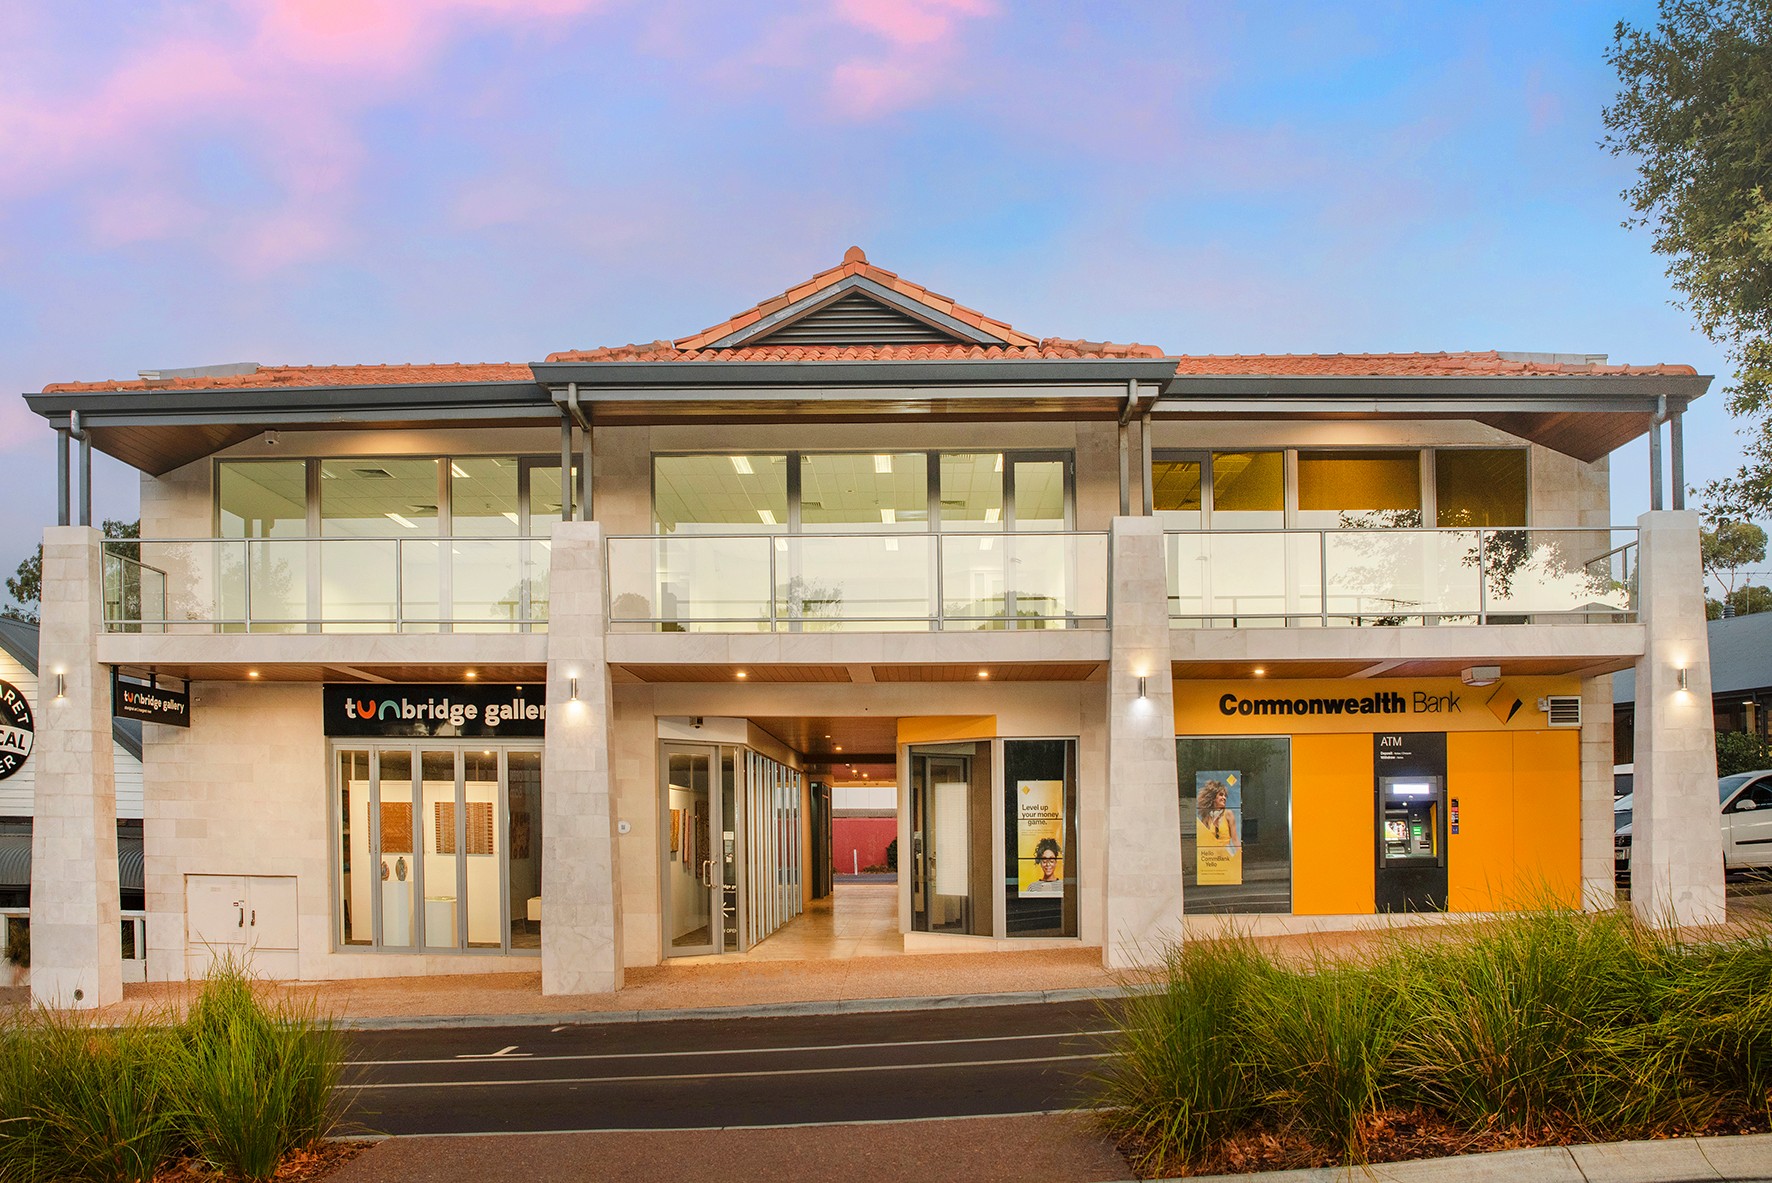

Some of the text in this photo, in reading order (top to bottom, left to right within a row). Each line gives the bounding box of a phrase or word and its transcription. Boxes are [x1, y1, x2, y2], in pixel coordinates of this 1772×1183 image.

[124, 690, 162, 711] tunbridge
[162, 699, 185, 715] gallery
[345, 697, 478, 726] tunbridge
[1219, 691, 1462, 715] Commonwealth Bank
[1380, 736, 1402, 746] ATM
